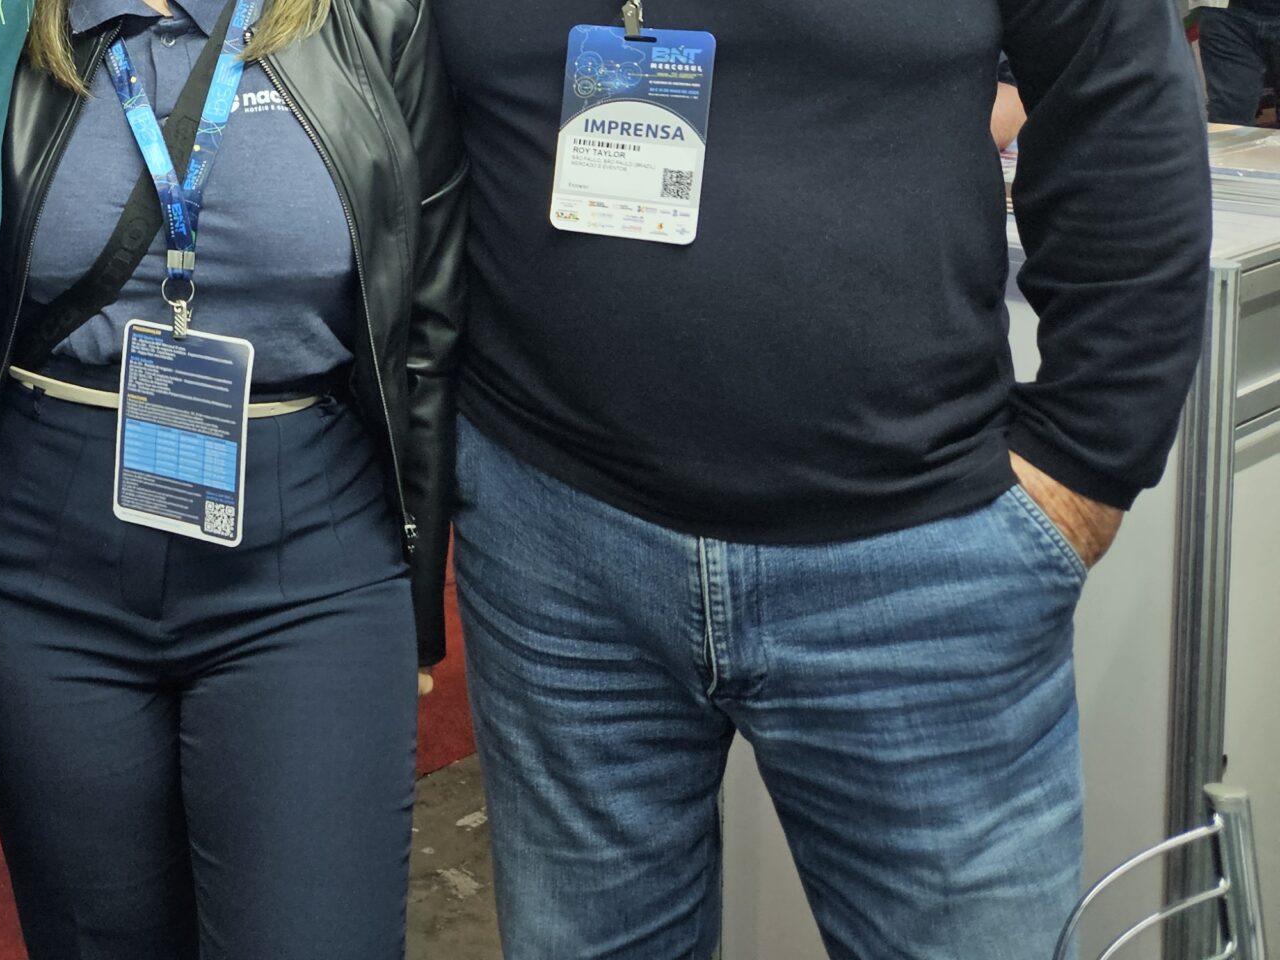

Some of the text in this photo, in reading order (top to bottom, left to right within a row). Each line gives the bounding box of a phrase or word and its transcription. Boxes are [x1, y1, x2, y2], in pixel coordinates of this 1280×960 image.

[651, 45, 703, 64] BNT
[649, 63, 703, 72] MERCOSUL
[584, 118, 685, 141] IMPRENSA
[573, 146, 626, 159] ROY TAYLOR
